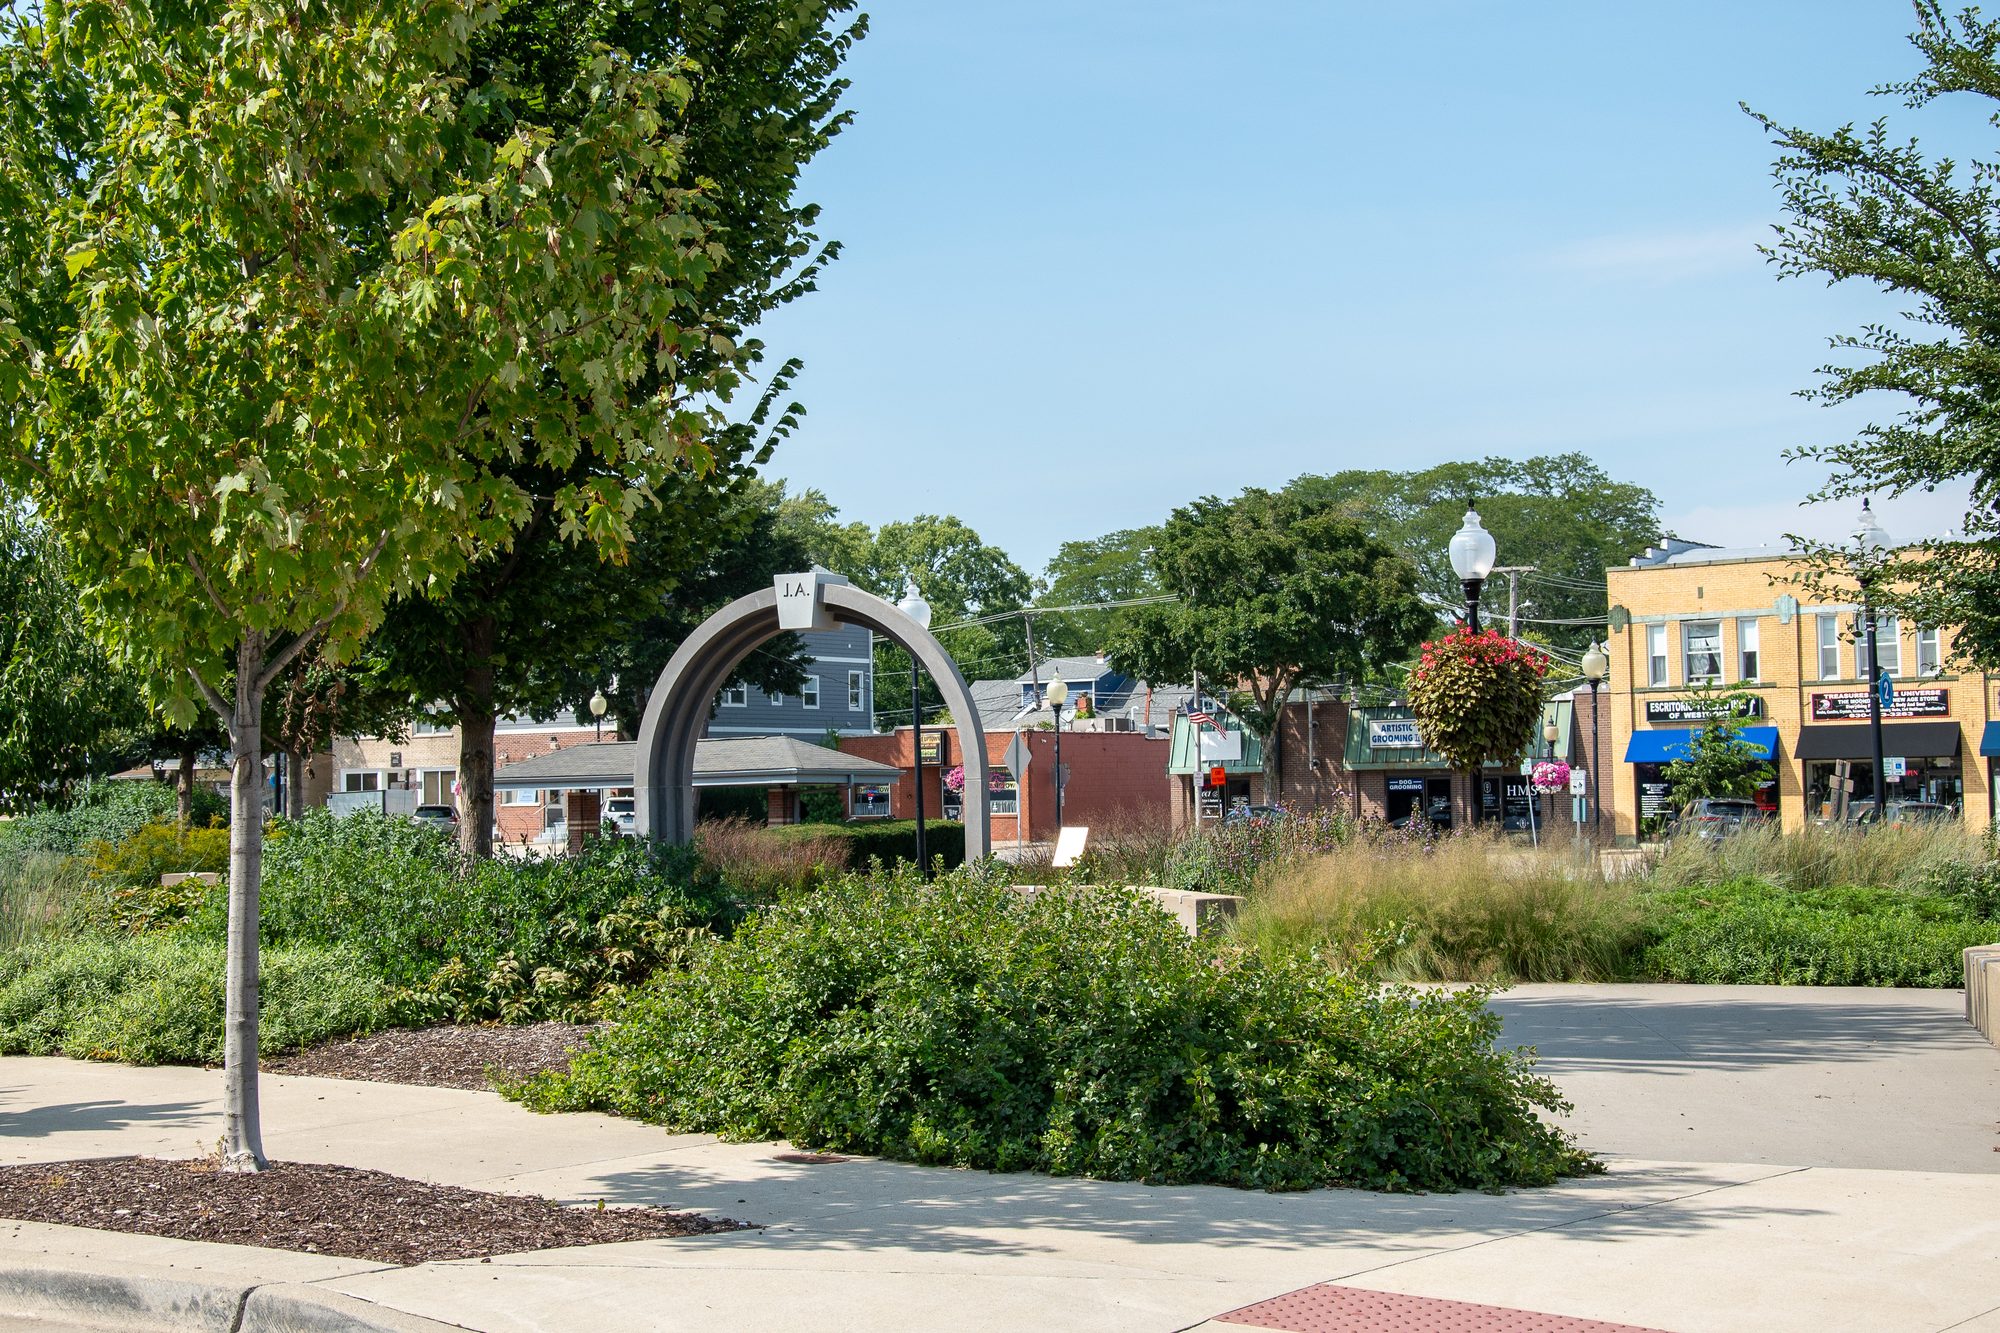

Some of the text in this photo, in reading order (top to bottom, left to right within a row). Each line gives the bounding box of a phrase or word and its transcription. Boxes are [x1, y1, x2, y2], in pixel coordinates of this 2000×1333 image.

[783, 582, 810, 597] J.A.
[1883, 681, 1890, 699] 2
[1381, 724, 1413, 733] ARTISTIC
[1371, 734, 1413, 743] GROOMING
[1506, 785, 1538, 797] HMS
